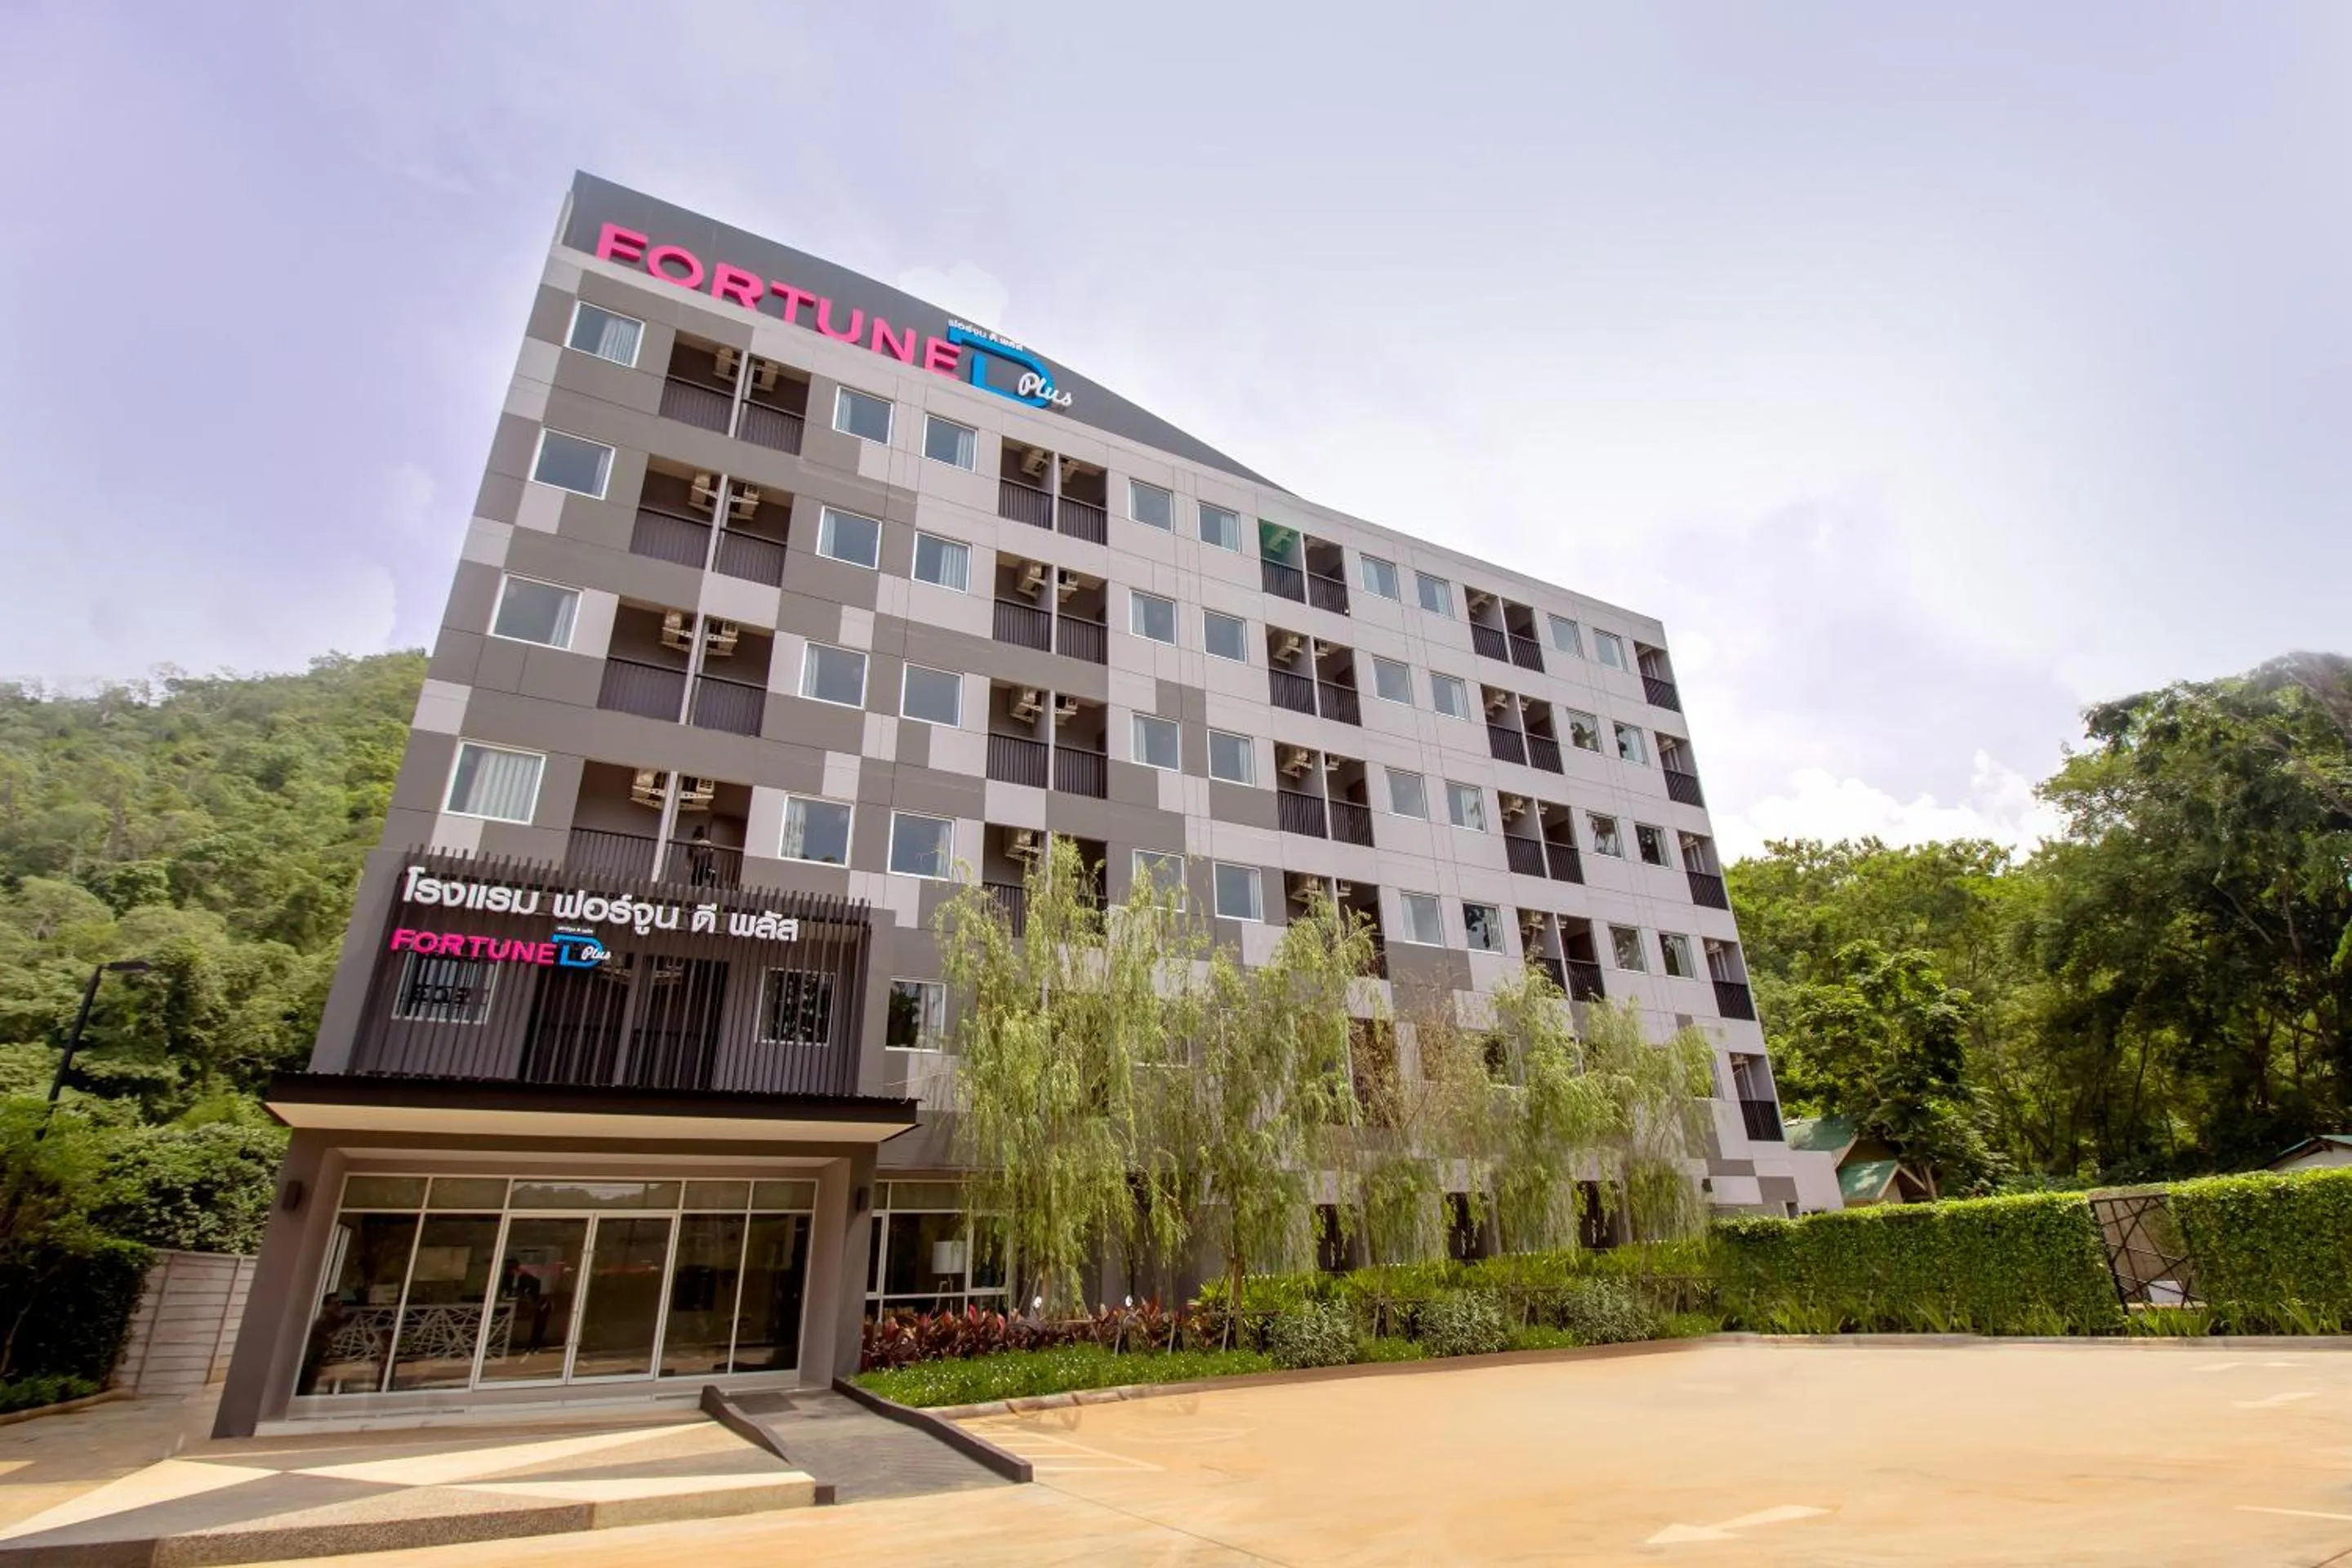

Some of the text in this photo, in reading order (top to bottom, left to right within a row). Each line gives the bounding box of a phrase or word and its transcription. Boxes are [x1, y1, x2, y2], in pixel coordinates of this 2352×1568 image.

[595, 222, 962, 381] FORTUNE
[1018, 372, 1073, 407] Plus
[402, 866, 800, 942] โรงแรม ฟอร์จูน ดี พลัส
[390, 928, 557, 967] FORTUNE
[581, 945, 612, 960] Plus
